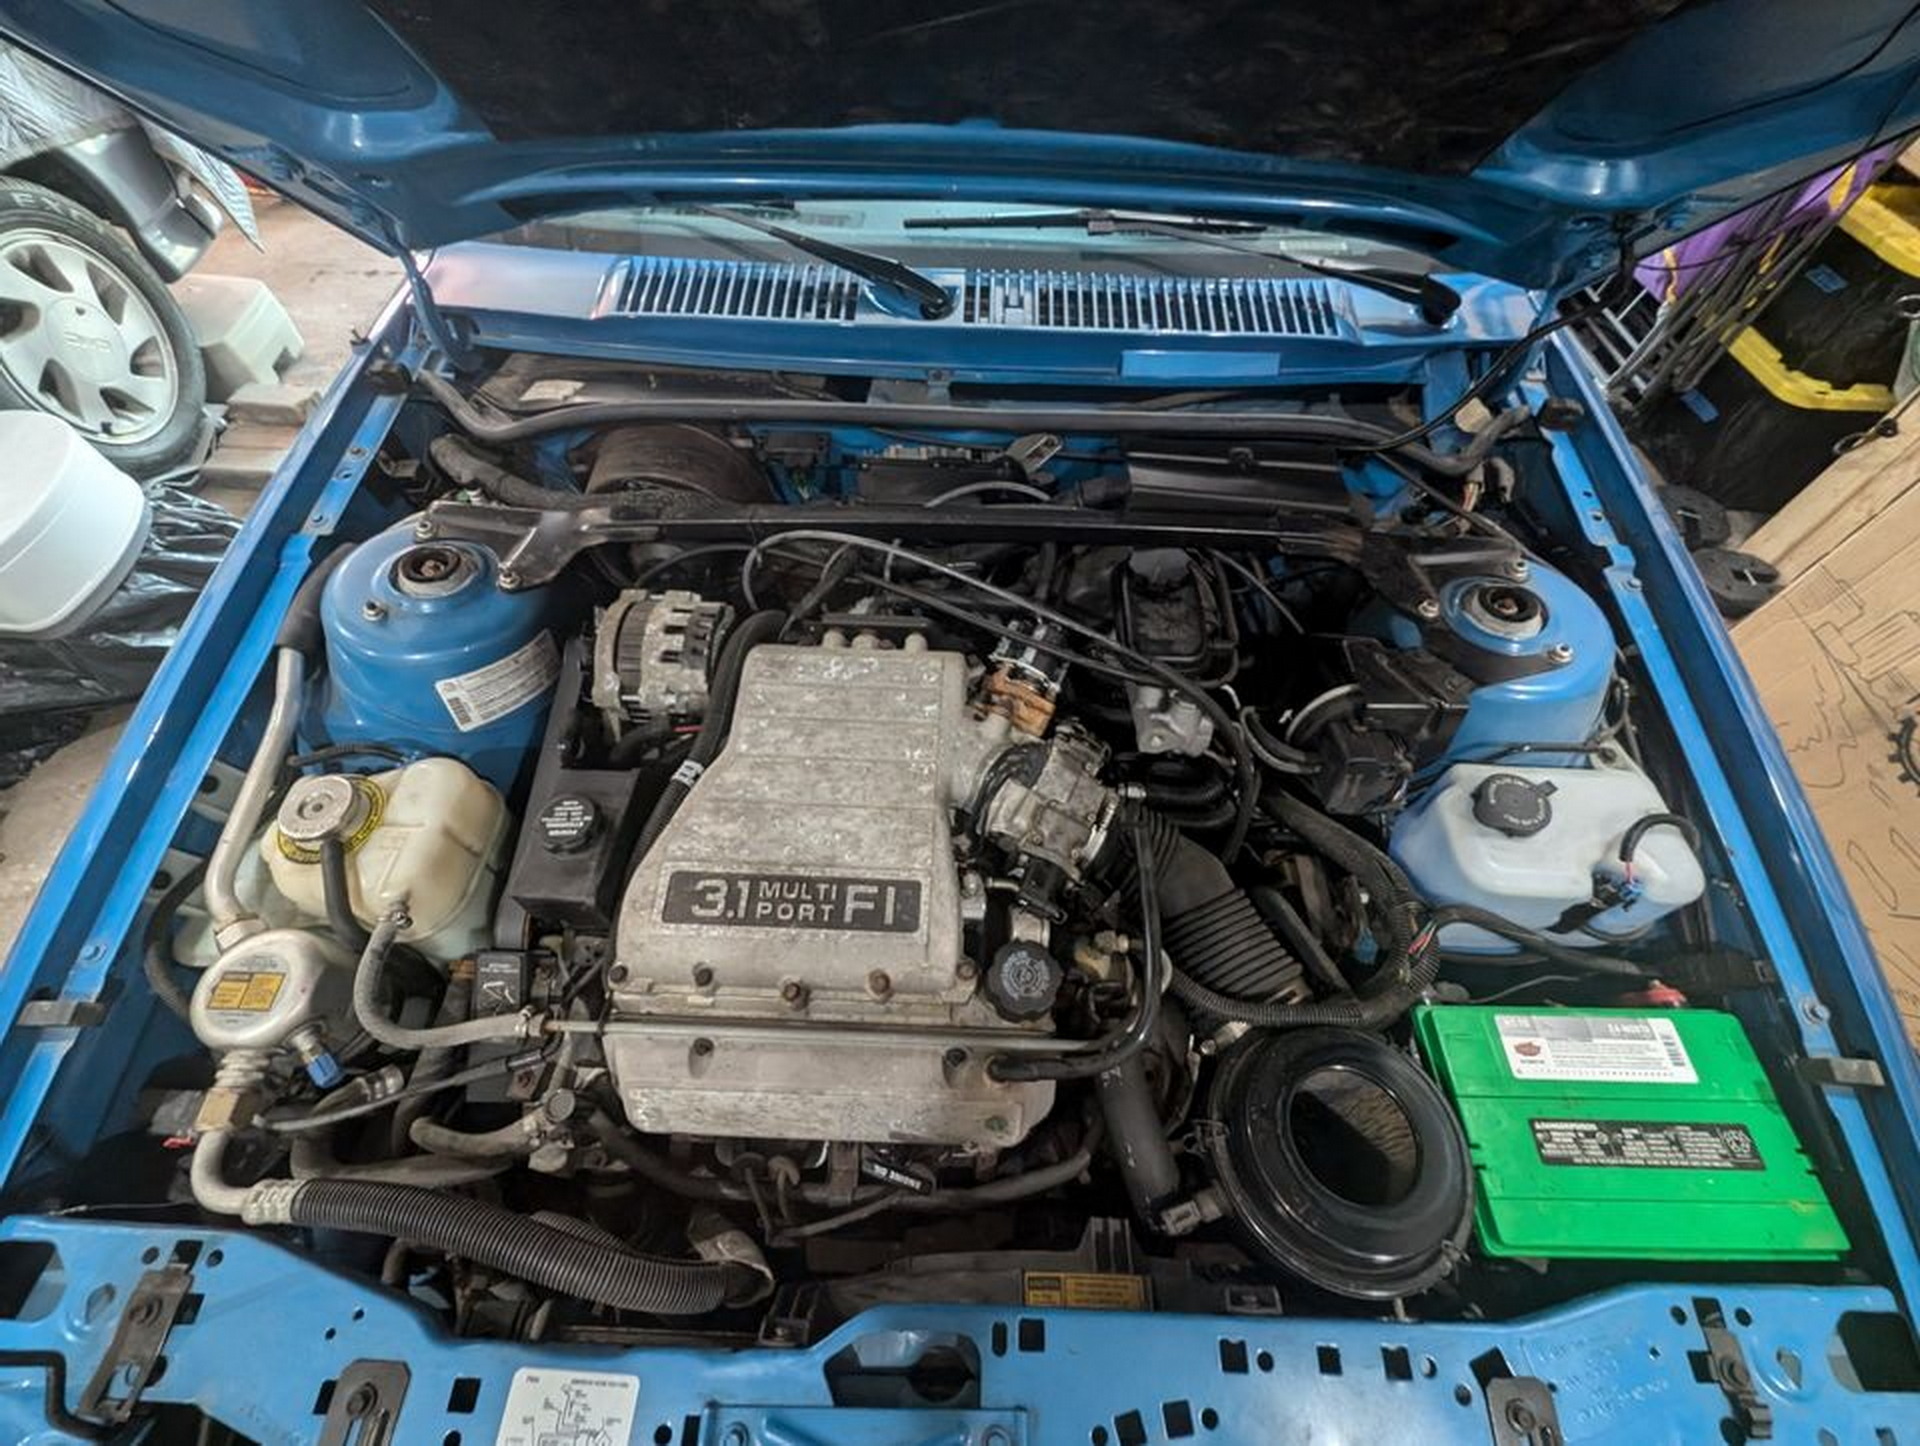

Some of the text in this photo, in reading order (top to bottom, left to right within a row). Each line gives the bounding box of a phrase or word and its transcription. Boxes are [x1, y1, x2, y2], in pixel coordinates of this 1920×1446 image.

[691, 879, 750, 918] 3.1
[759, 880, 837, 900] MULTI
[844, 884, 896, 925] FI
[755, 902, 834, 921] PORT
